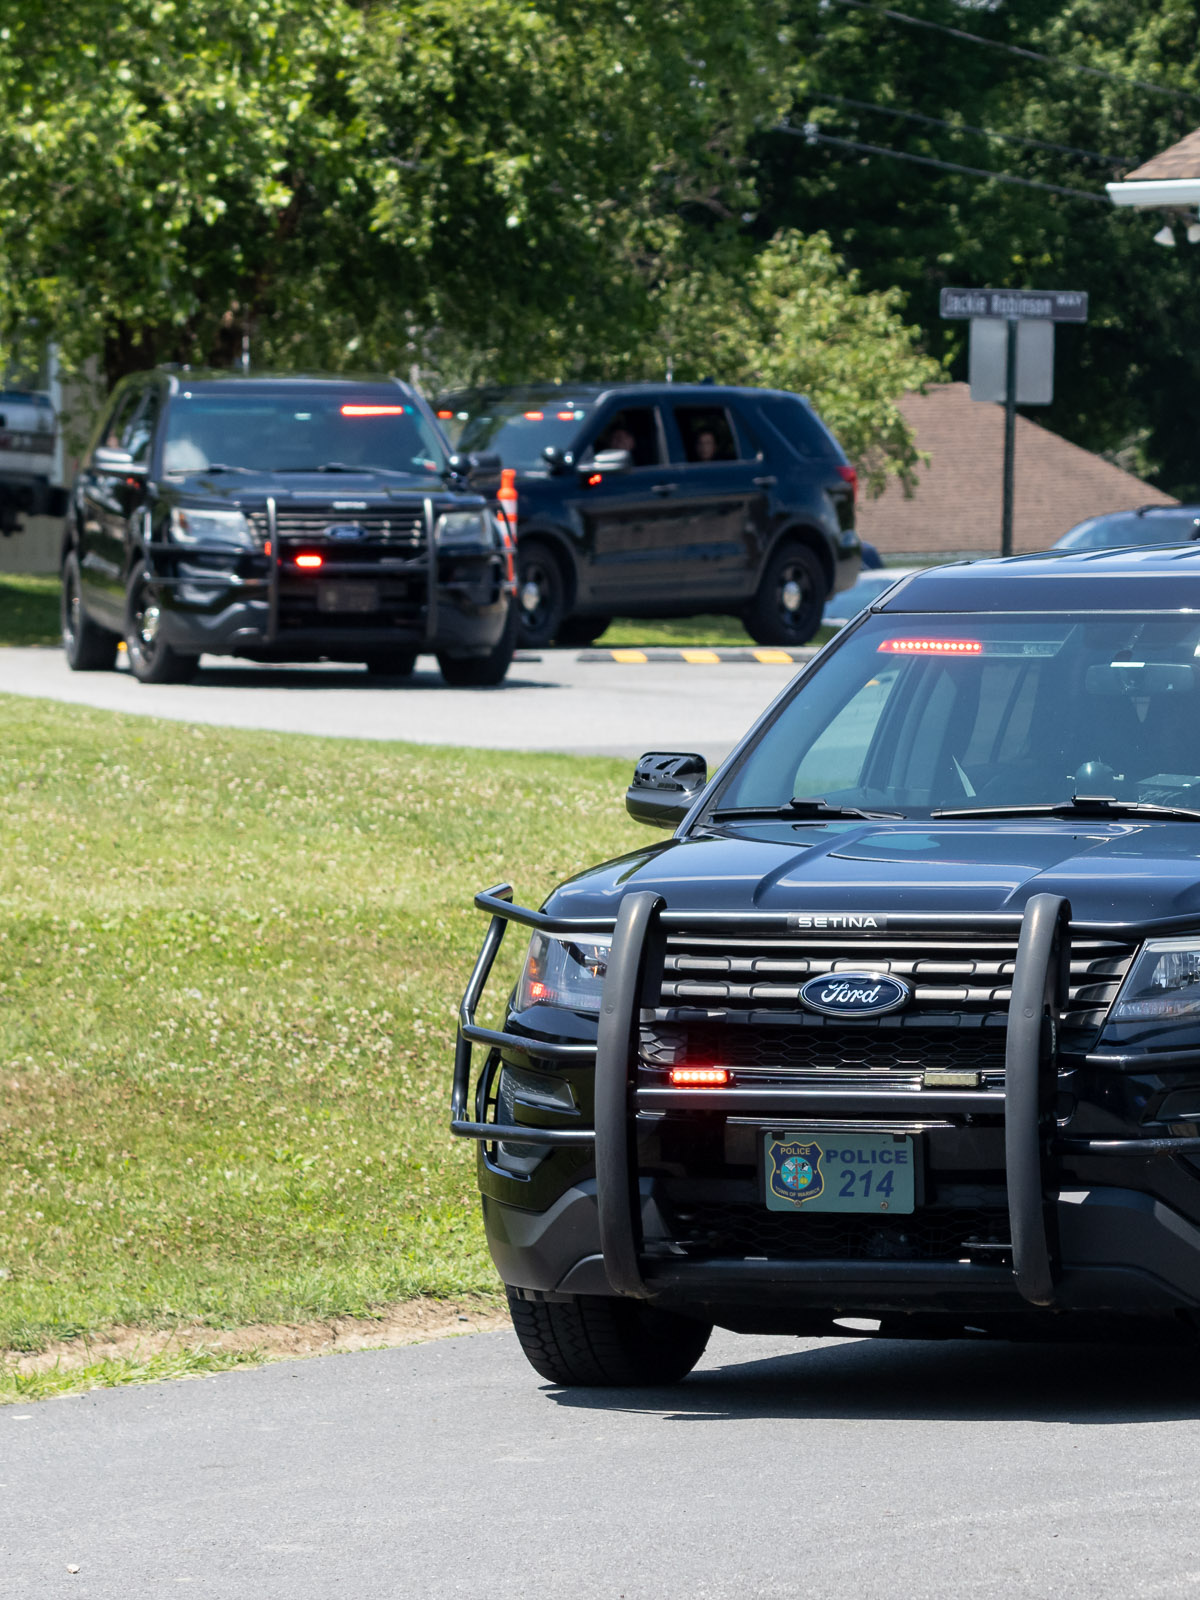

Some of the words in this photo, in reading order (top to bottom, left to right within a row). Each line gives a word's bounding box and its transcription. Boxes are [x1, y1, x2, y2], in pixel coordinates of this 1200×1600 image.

[946, 292, 986, 314] Jackie
[991, 293, 1051, 315] Robinson
[798, 917, 878, 928] SETINA
[820, 982, 882, 1004] Ford
[780, 1147, 811, 1156] POLICE
[825, 1149, 908, 1165] POLICE
[838, 1169, 895, 1198] 214
